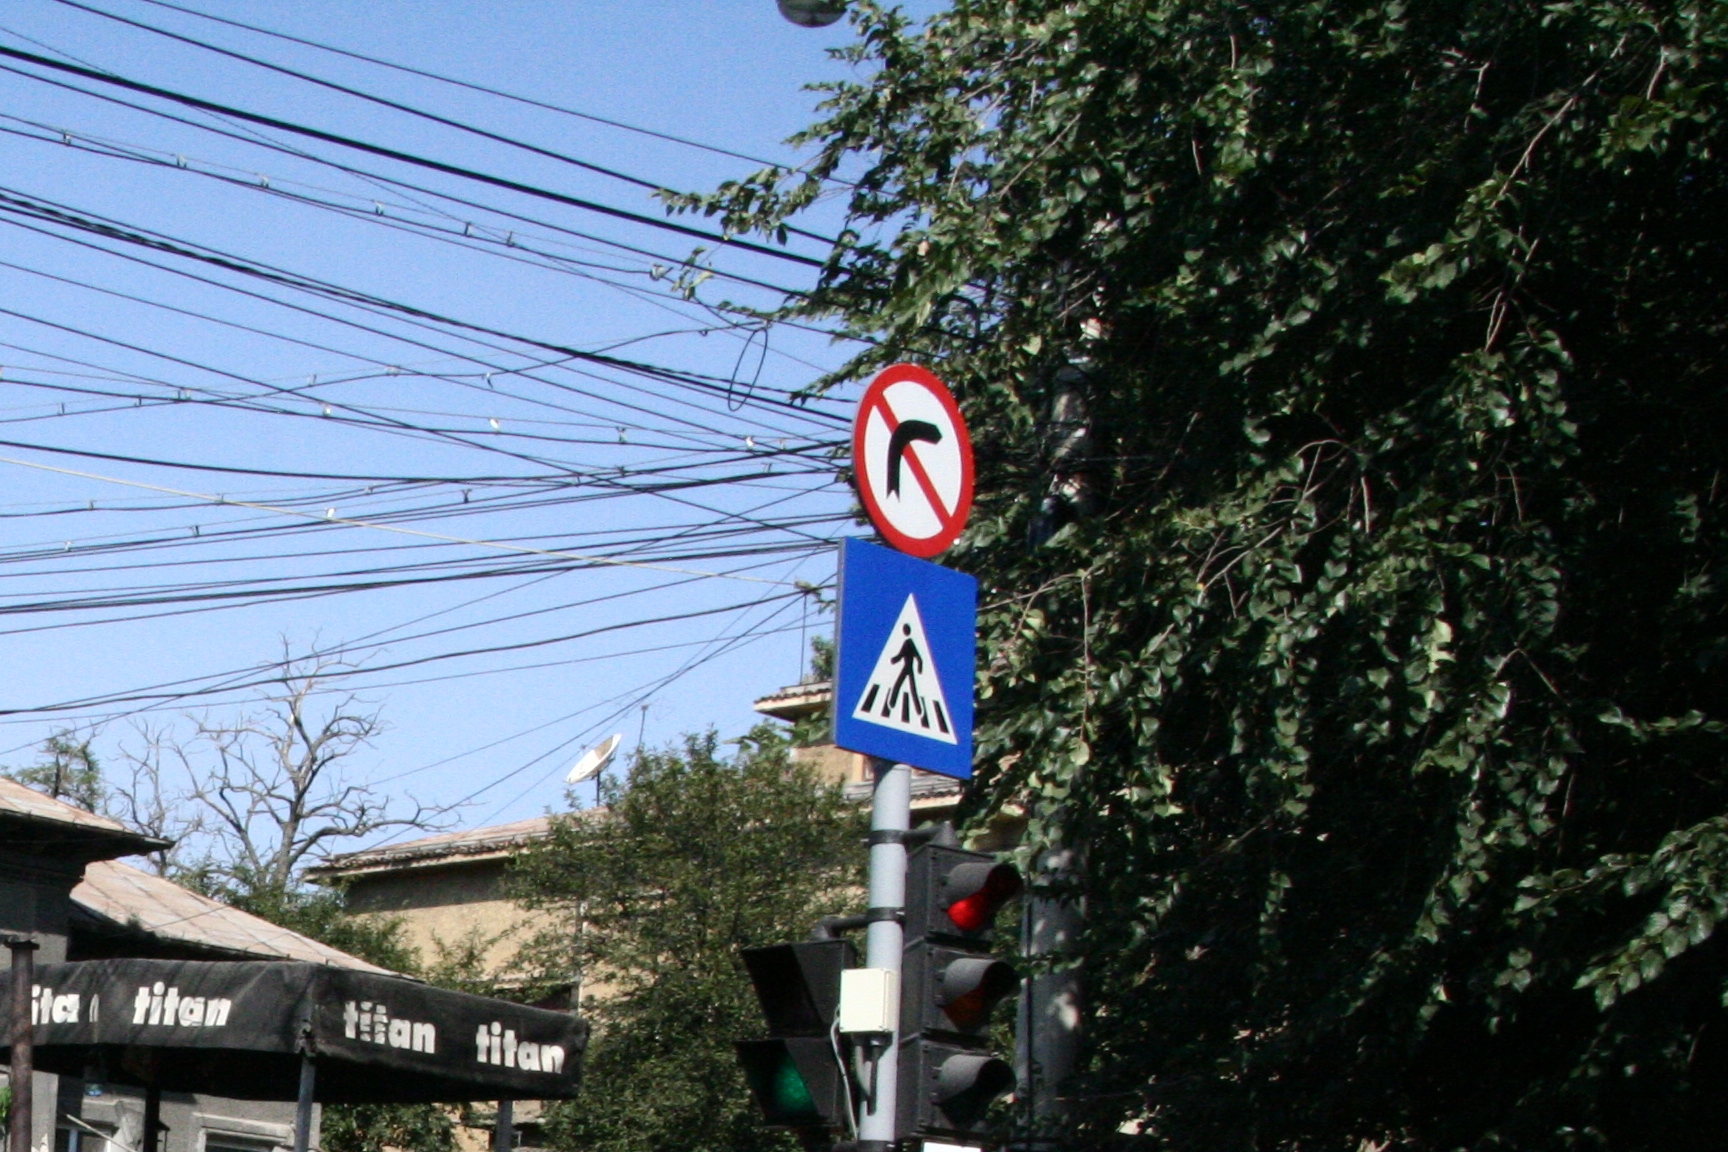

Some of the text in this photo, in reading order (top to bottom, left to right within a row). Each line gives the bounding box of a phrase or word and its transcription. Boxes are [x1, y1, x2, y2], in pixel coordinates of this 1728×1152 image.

[133, 981, 232, 1027] titan
[343, 1000, 565, 1075] titan titan
